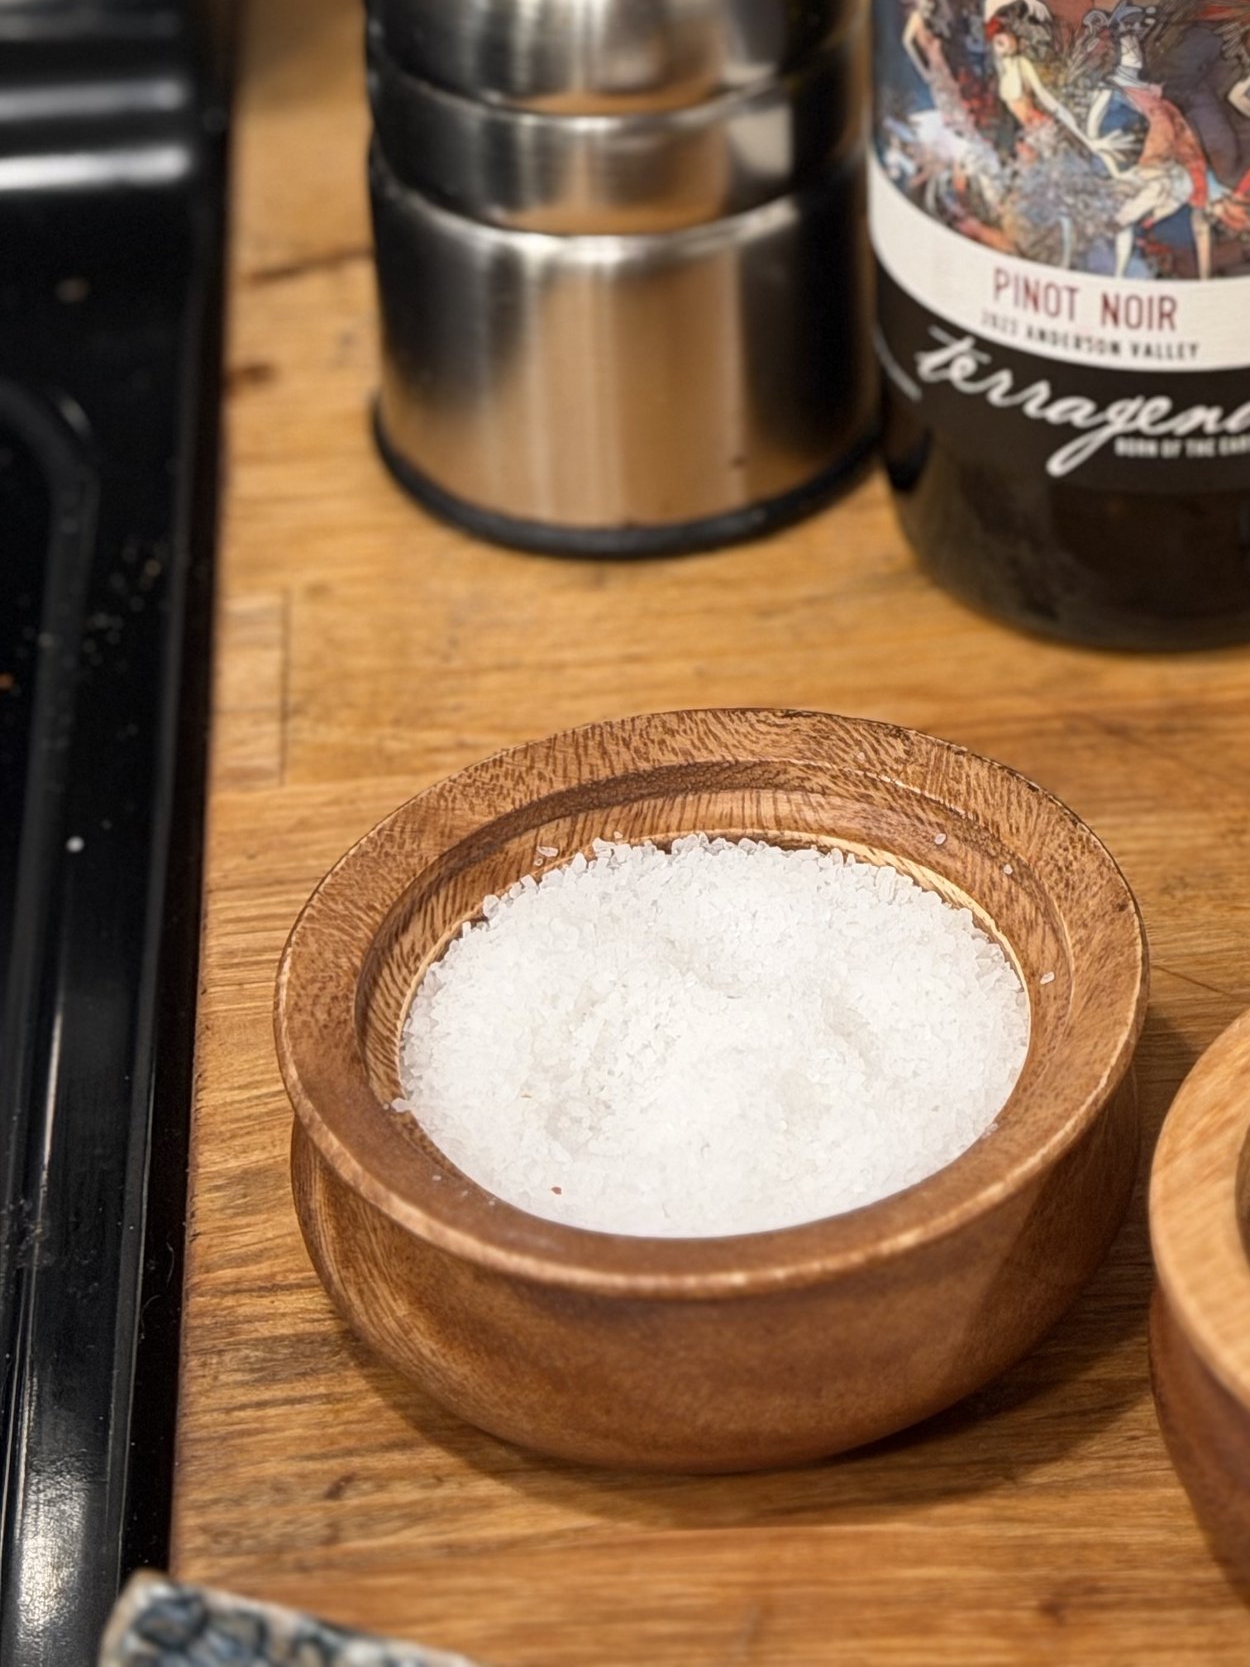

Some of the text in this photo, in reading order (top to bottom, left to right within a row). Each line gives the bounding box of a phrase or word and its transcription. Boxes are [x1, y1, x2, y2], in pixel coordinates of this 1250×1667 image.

[993, 266, 1178, 331] PINOT NOIR
[1026, 323, 1121, 355] ANDERSON
[1130, 341, 1200, 359] VALLEY
